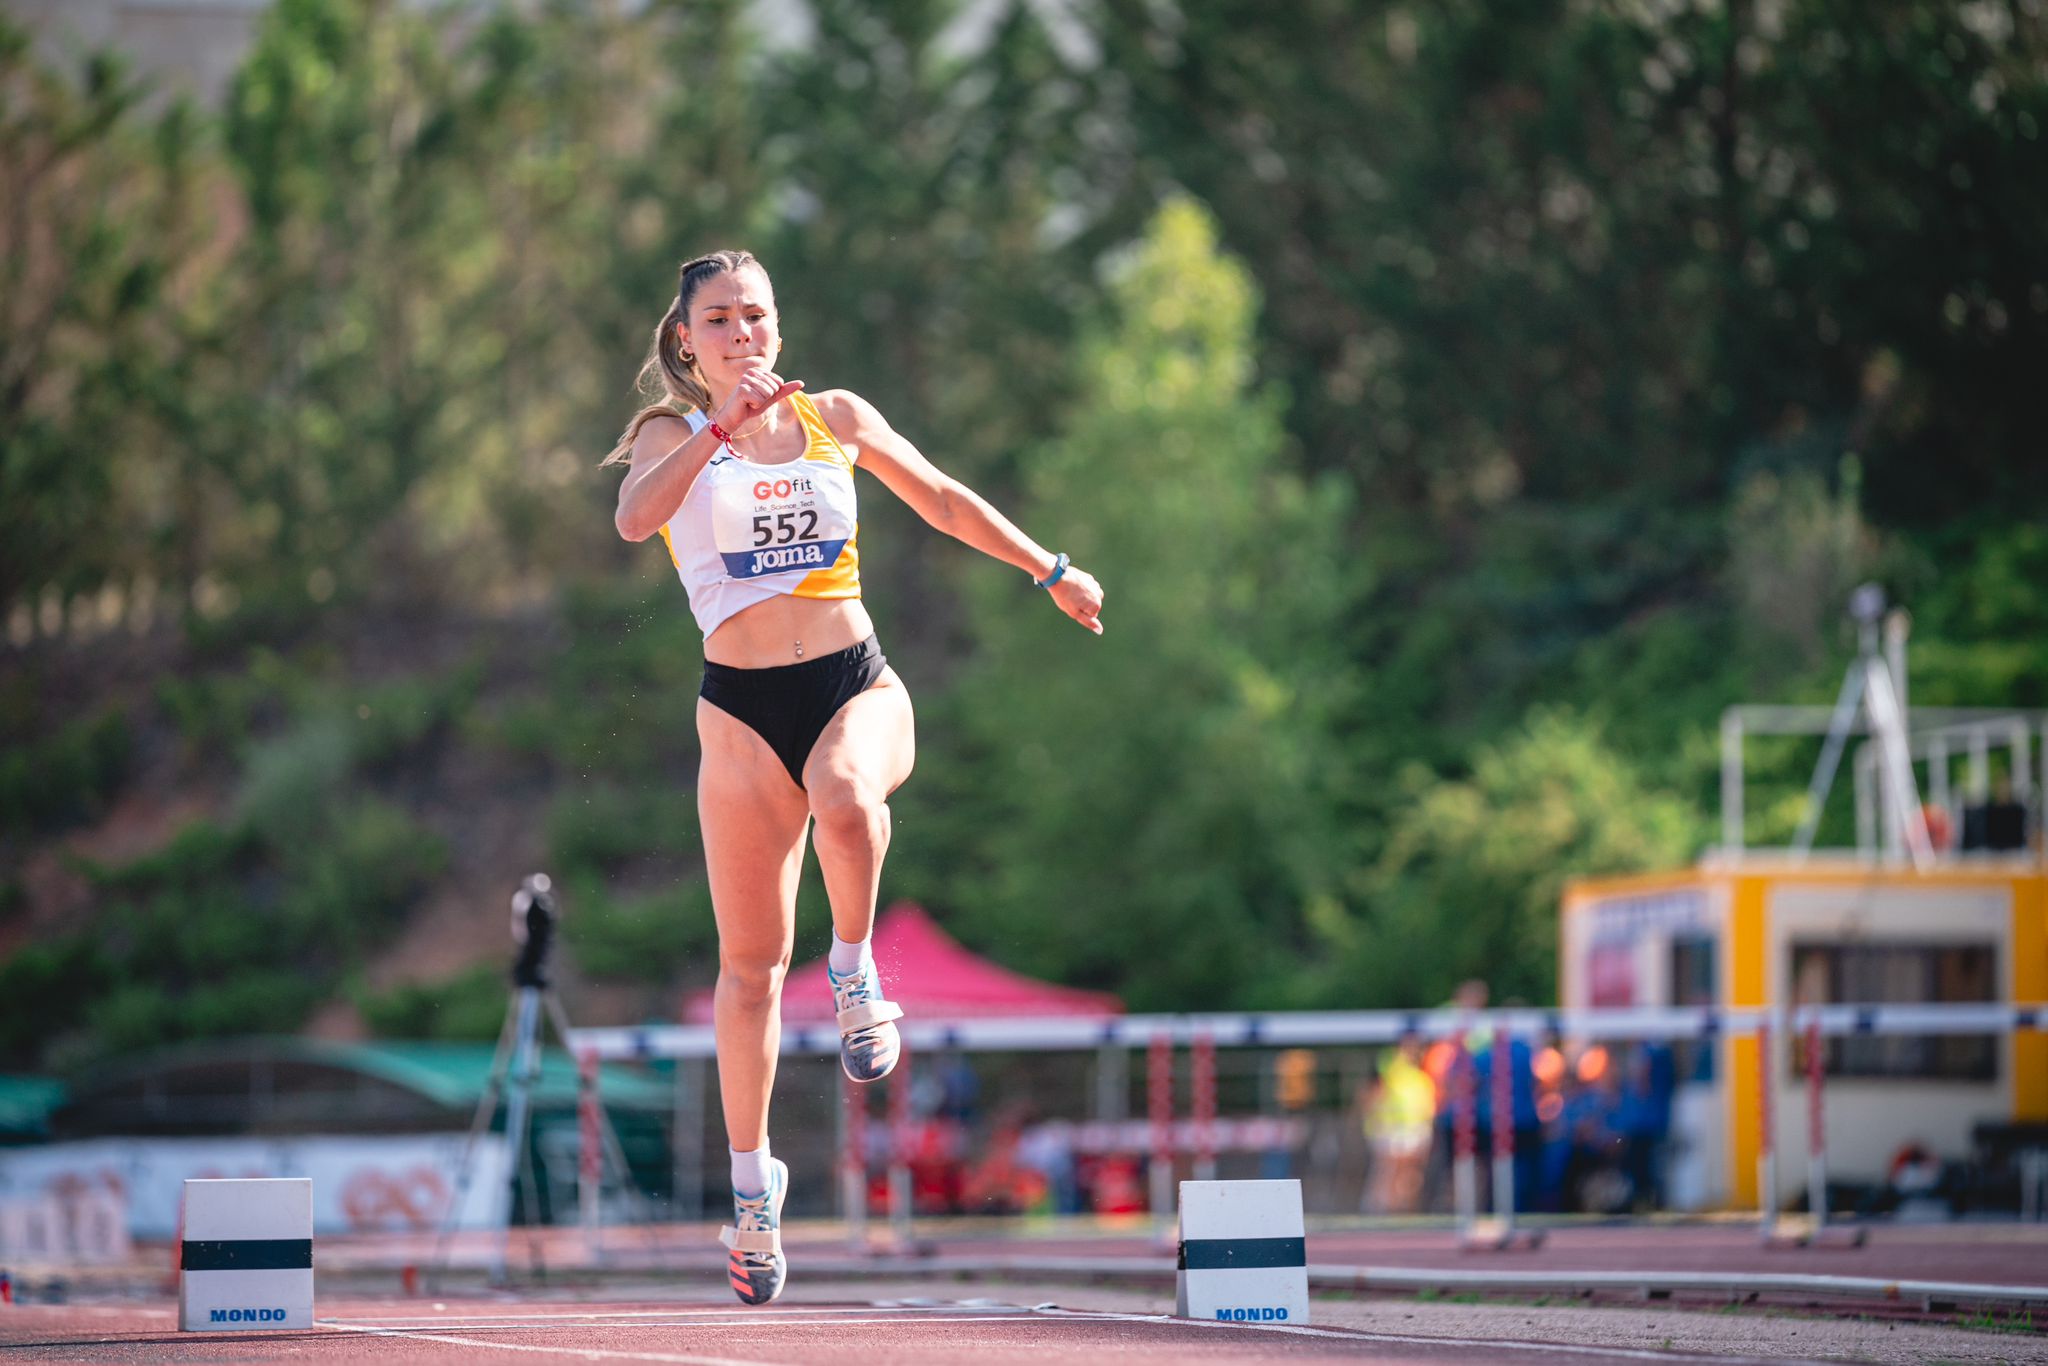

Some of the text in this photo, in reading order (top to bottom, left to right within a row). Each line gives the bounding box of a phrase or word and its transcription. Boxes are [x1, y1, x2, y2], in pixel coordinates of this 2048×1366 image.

[753, 510, 819, 547] 552
[210, 1309, 286, 1322] MONDO
[1216, 1308, 1288, 1321] MONDO
